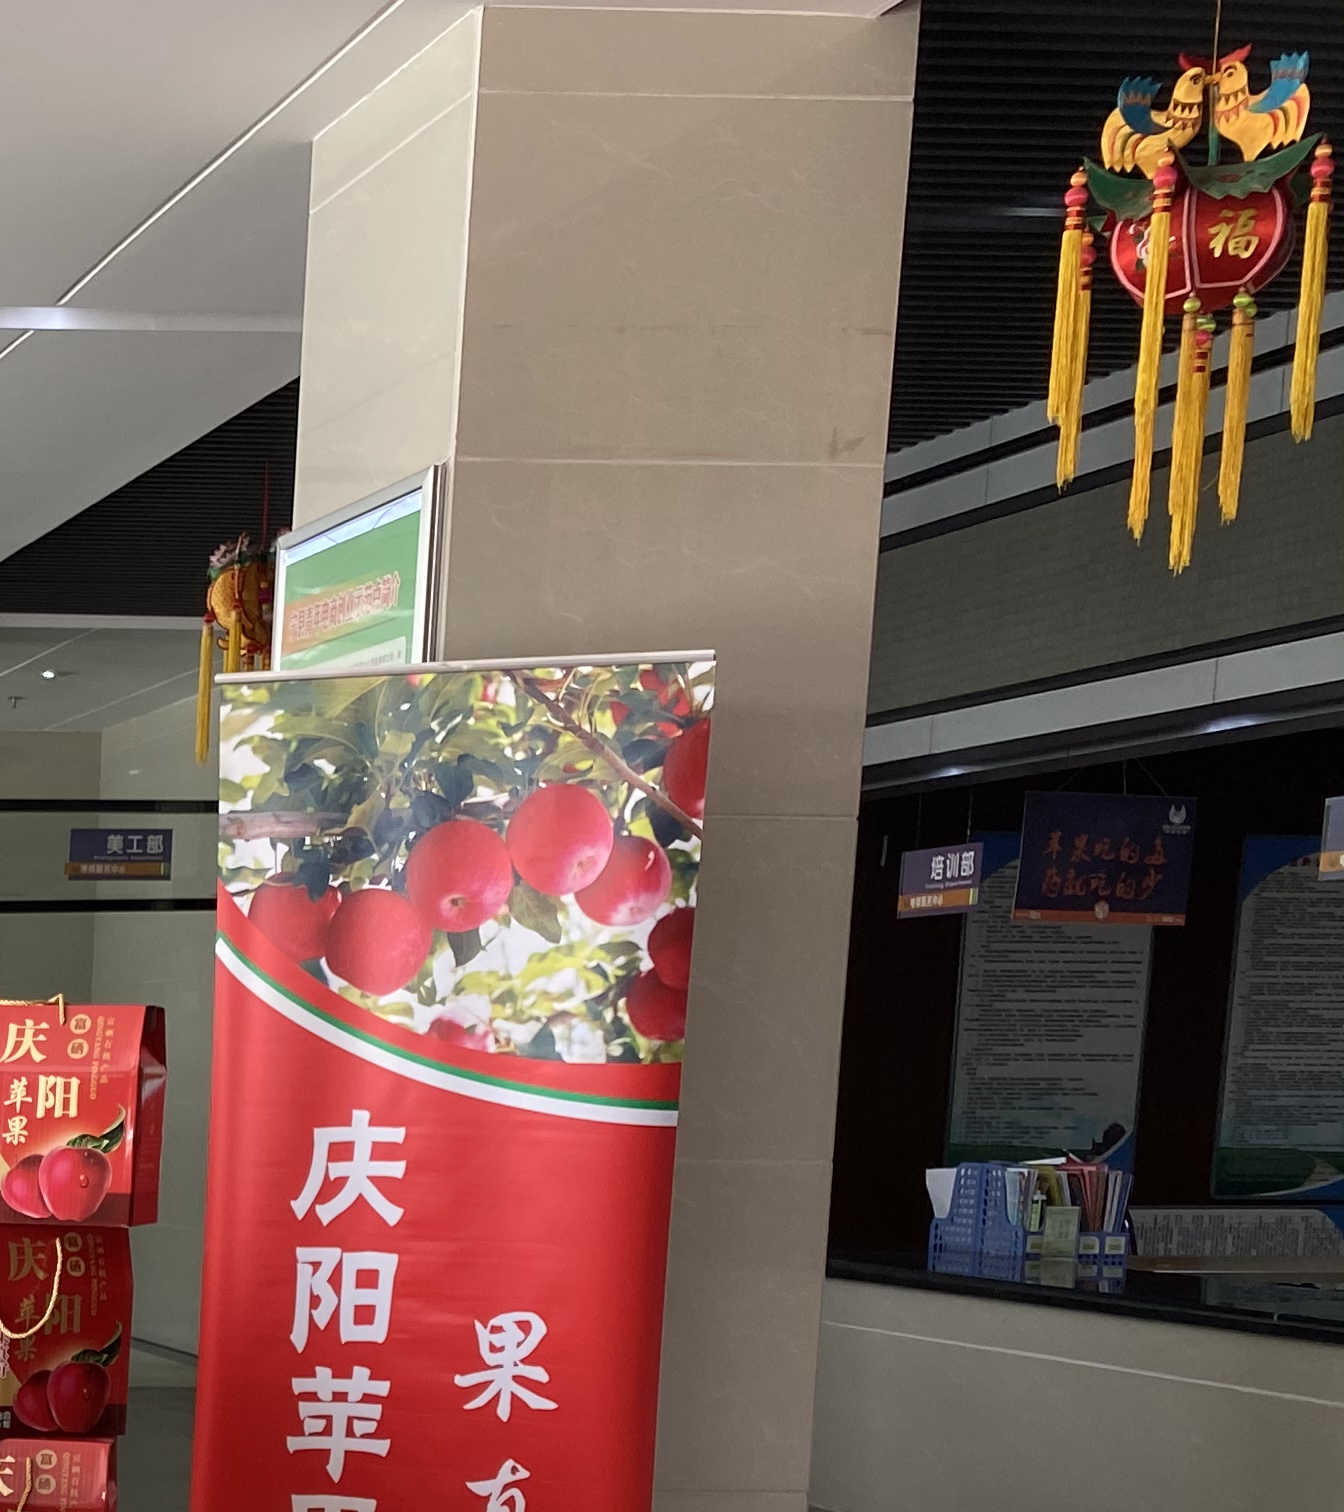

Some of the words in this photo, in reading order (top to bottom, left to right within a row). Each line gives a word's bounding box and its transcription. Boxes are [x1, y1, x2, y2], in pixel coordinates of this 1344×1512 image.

[1208, 206, 1260, 260] 福
[107, 834, 163, 854] 美工部
[930, 851, 975, 880] 培训部
[2, 1076, 33, 1146] 苹果
[13, 1294, 41, 1362] 苹果
